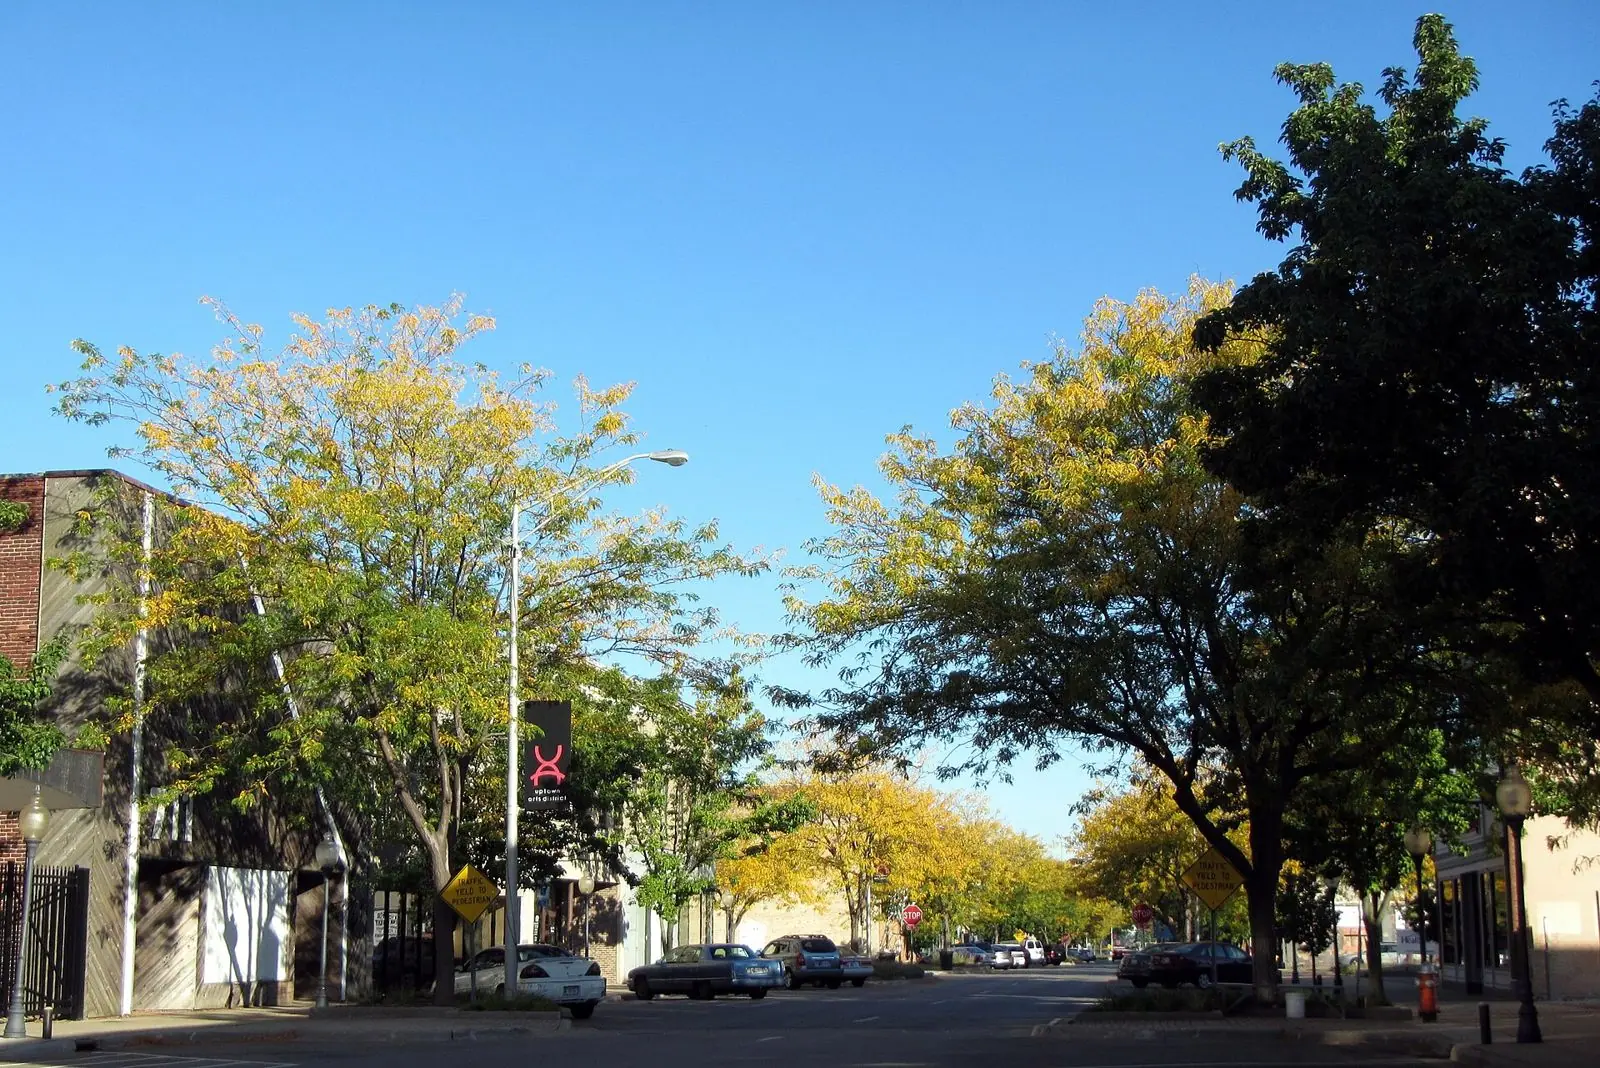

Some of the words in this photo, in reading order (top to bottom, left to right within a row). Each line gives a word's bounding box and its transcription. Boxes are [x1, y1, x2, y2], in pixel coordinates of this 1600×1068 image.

[534, 788, 561, 796] uptown
[1222, 872, 1230, 880] TO
[458, 877, 484, 886] TRAFFIC
[456, 888, 473, 896] YIELD
[451, 896, 491, 905] PEDESTRIAN
[904, 911, 921, 920] STOP
[1133, 909, 1151, 918] STOP
